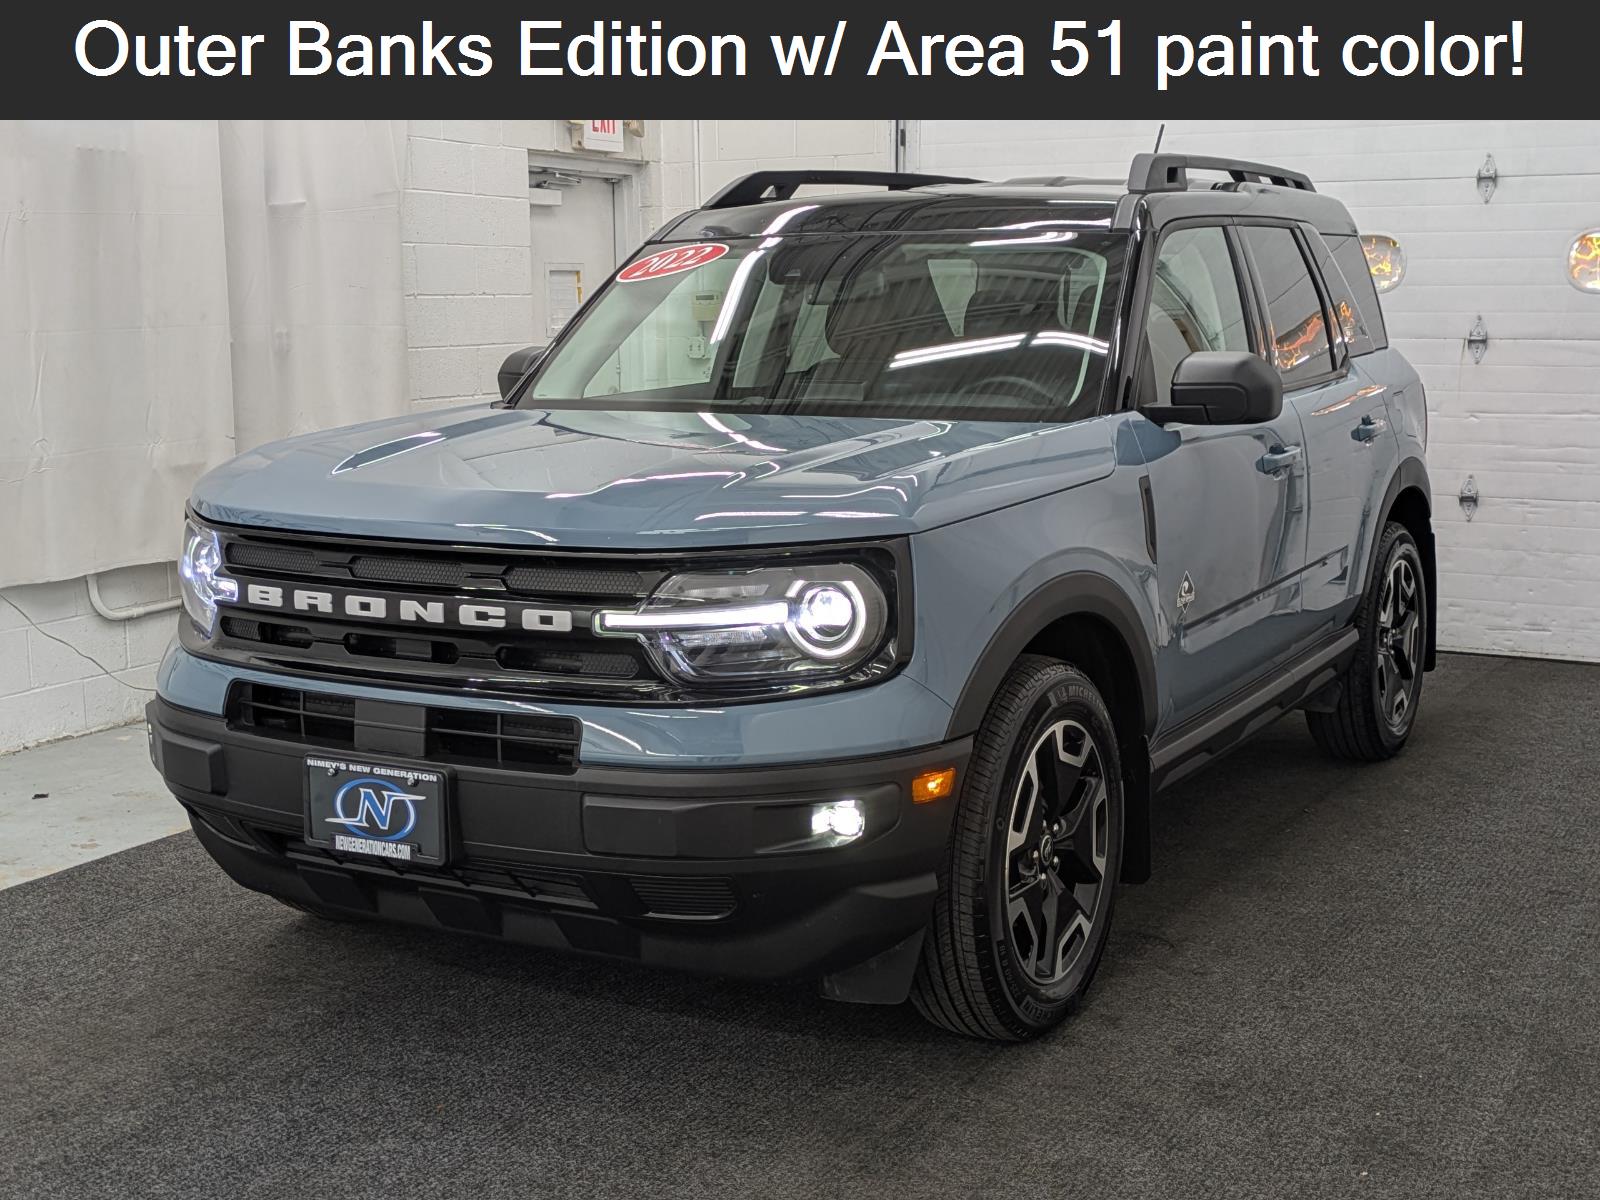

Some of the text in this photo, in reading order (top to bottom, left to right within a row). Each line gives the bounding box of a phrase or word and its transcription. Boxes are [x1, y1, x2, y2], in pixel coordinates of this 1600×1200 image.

[630, 247, 713, 277] 2022
[247, 583, 573, 632] BRONCO
[306, 758, 437, 782] NIMEY'S NEW GENERATION
[335, 834, 411, 861] NEWGENERATIONCARS.COM
